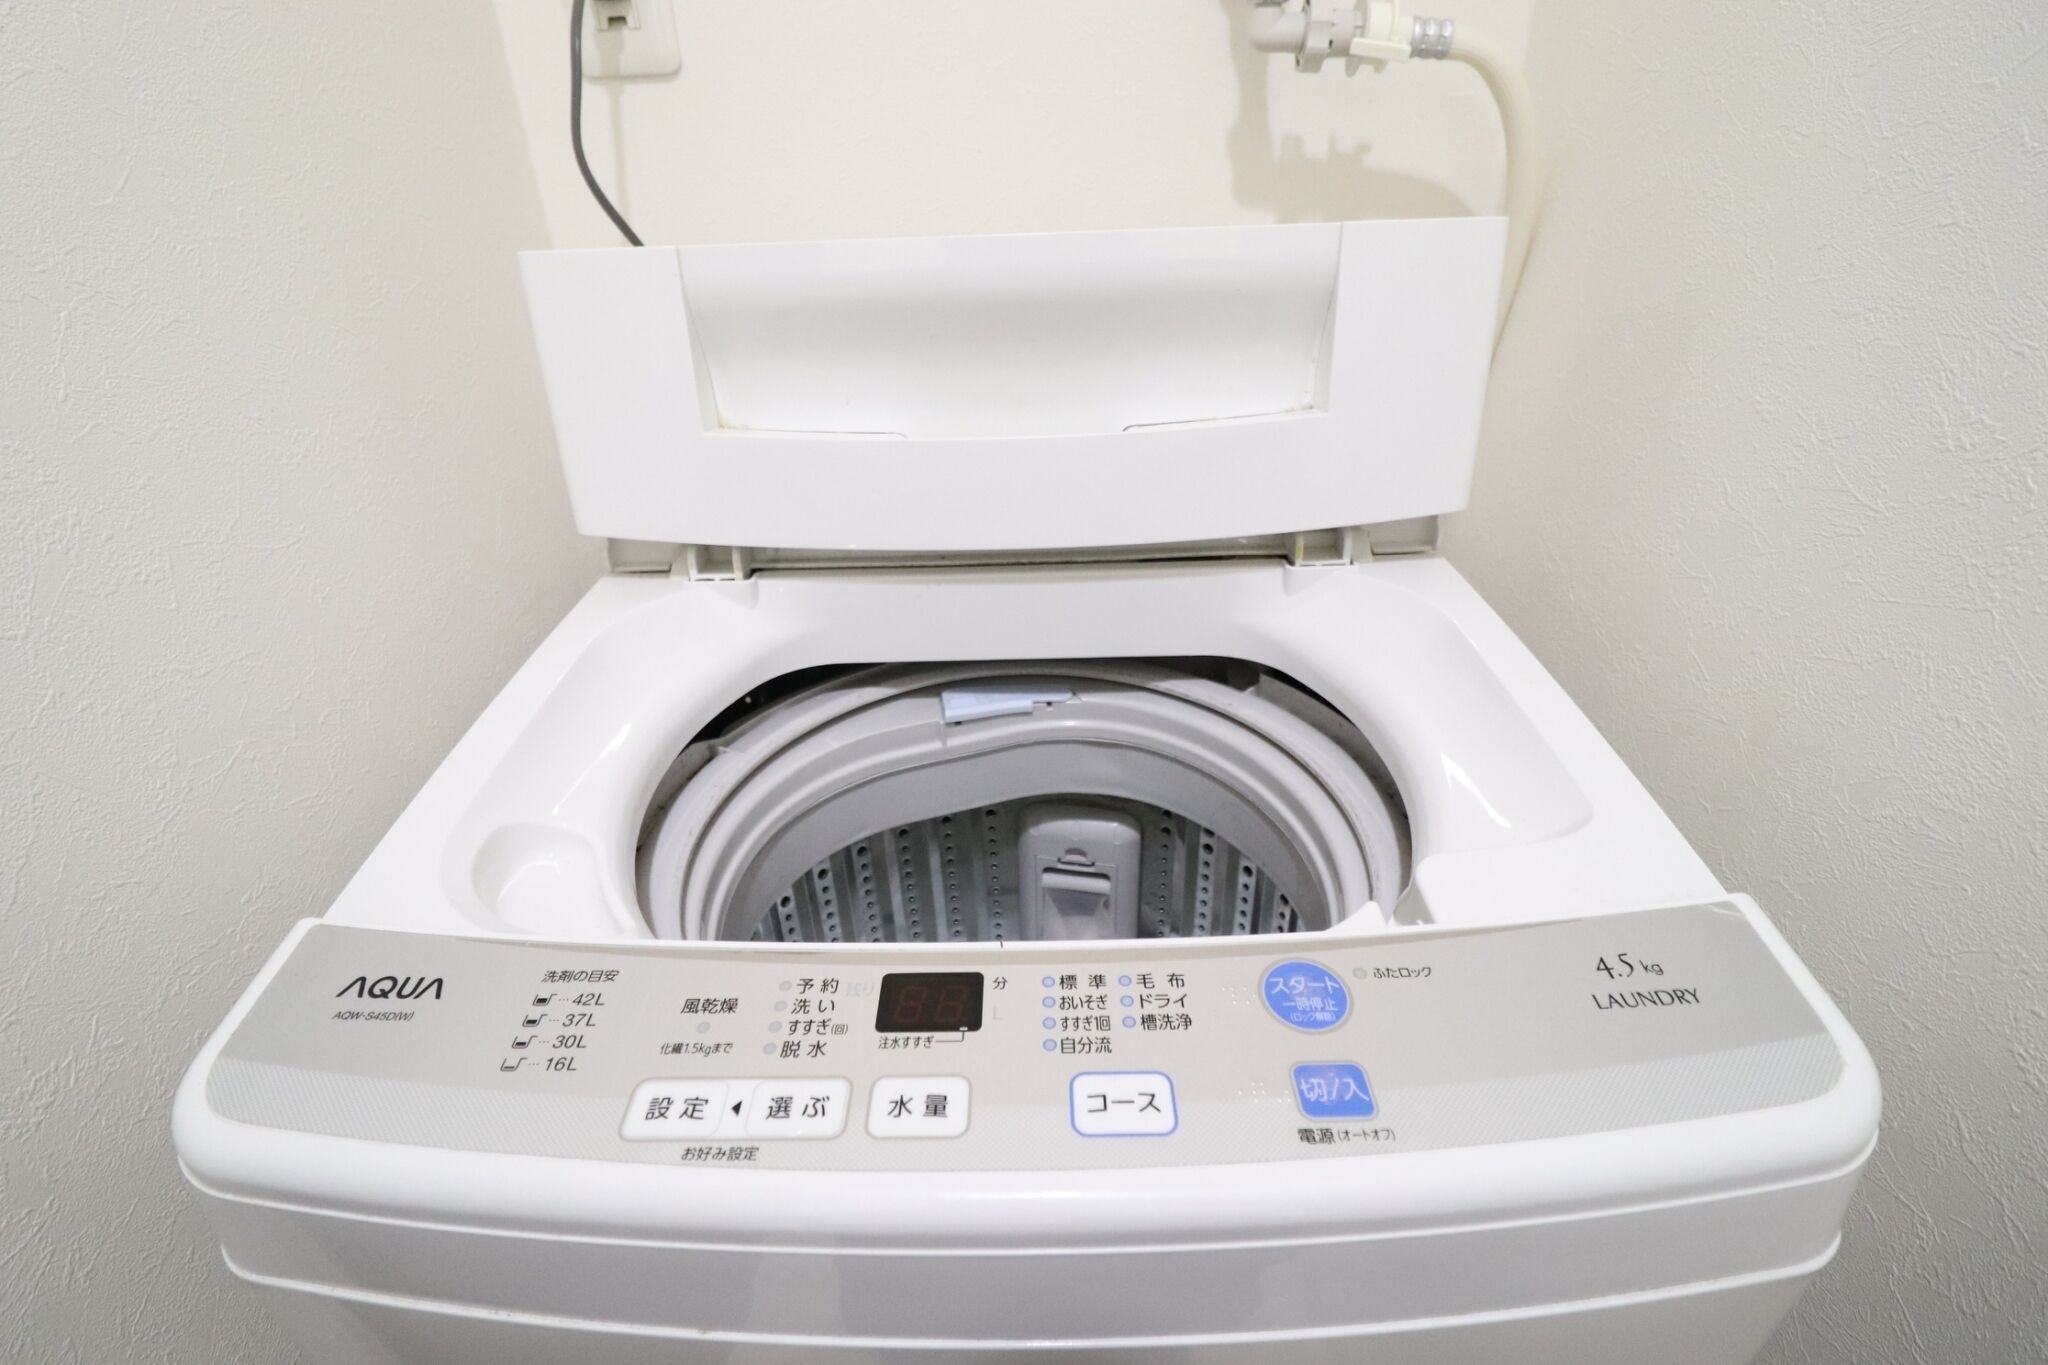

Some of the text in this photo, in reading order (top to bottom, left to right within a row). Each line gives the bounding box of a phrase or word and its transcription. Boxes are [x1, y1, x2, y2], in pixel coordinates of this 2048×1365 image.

[1373, 967, 1431, 979] ふたロック
[1596, 953, 1664, 979] 4.5 kg
[541, 969, 620, 983] 洗剤の目安
[993, 977, 1007, 990] 分
[1059, 974, 1107, 990] 標準
[1136, 973, 1185, 989] 毛布
[335, 976, 443, 1000] AQUA
[796, 978, 839, 994] 予約
[1270, 976, 1339, 994] スタート
[572, 993, 605, 1007] 42L
[680, 998, 738, 1014] 風乾燥
[791, 998, 835, 1014] 洗い
[1059, 995, 1107, 1010] おいそぎ
[1139, 993, 1187, 1008] ドライ
[1592, 988, 1700, 1010] LAUNDRY
[331, 1011, 414, 1021] AQW-S45D(W)
[562, 1014, 596, 1027] 37L
[1060, 1015, 1111, 1031] すすぎ1回
[1140, 1013, 1192, 1031] 槽洗浄
[552, 1035, 587, 1049] 30L
[780, 1041, 827, 1058] 脱水
[878, 1035, 934, 1049] 注水すすぎ
[1060, 1037, 1112, 1054] 自分流
[544, 1057, 577, 1072] 16L
[1301, 1077, 1370, 1102] 切/入
[645, 1097, 709, 1120] 設定
[766, 1095, 830, 1120] 選ぶ
[888, 1094, 948, 1118] 水量
[1087, 1092, 1161, 1114] コース
[681, 1147, 759, 1162] お好み設定
